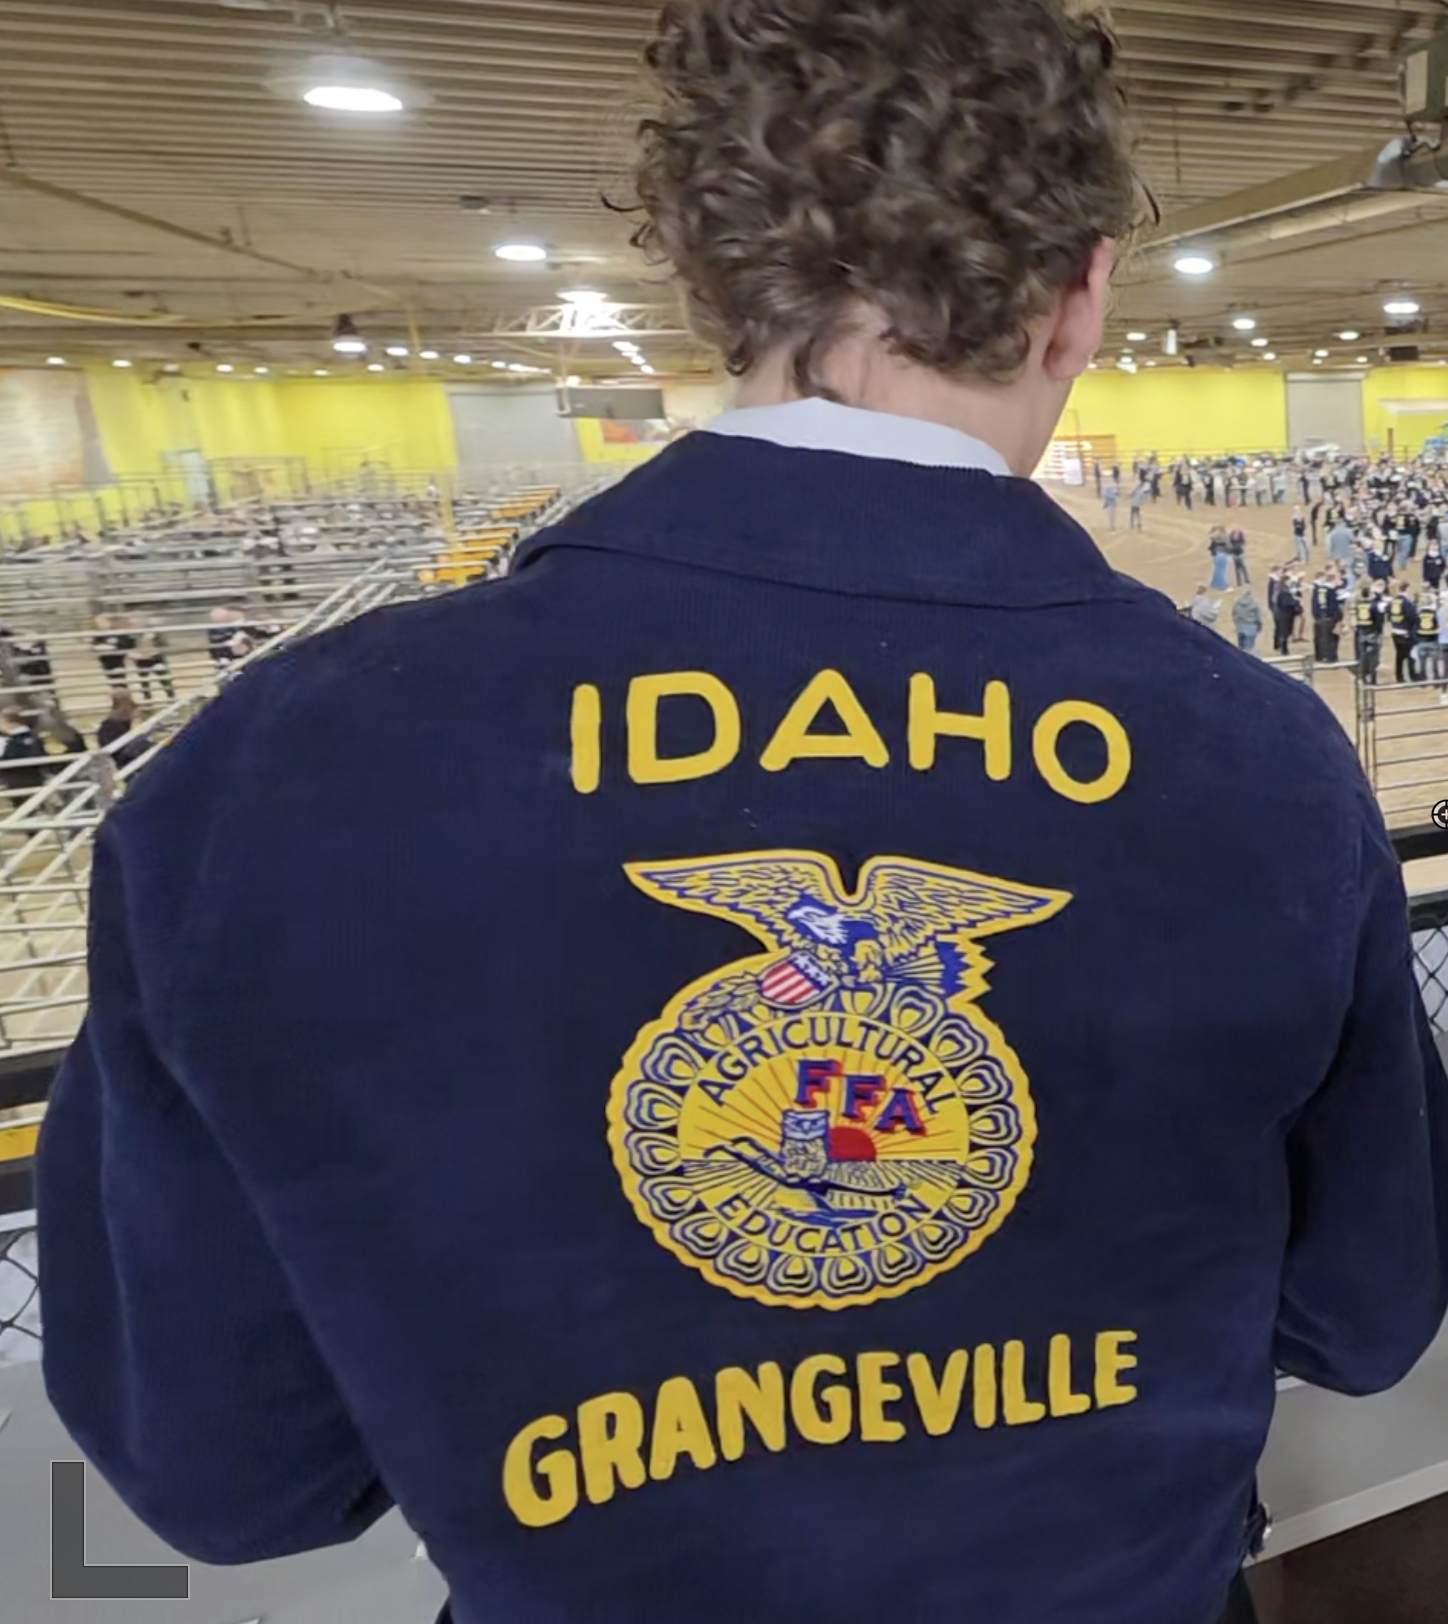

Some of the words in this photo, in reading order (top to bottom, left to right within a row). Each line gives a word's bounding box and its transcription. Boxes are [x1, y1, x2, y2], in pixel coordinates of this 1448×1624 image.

[570, 668, 1132, 804] IDAHO
[697, 1015, 957, 1115] AGRICULTURAL
[793, 1058, 928, 1138] FFA
[713, 1193, 933, 1252] EDUCATION
[502, 1330, 1138, 1528] GRANGEVILLE
